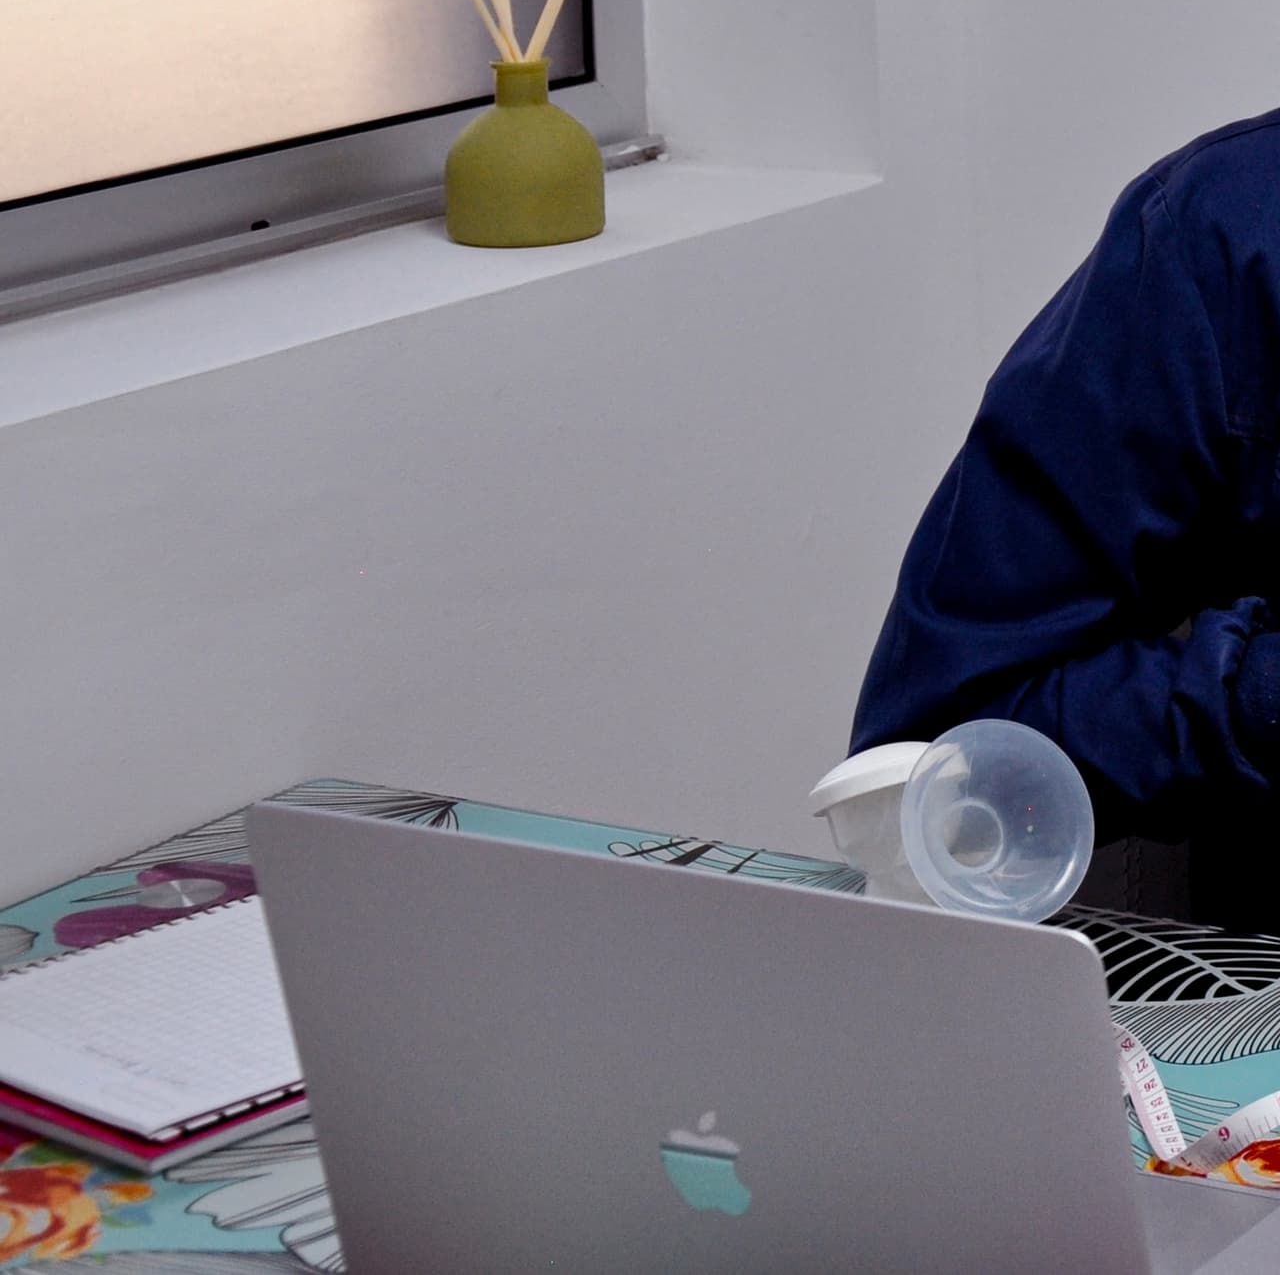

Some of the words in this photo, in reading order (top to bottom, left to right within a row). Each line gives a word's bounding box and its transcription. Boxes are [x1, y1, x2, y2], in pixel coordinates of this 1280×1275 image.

[1136, 1058, 1149, 1073] 27
[1144, 1078, 1157, 1092] 26
[1151, 1096, 1164, 1108] 25
[1218, 1126, 1230, 1142] 6
